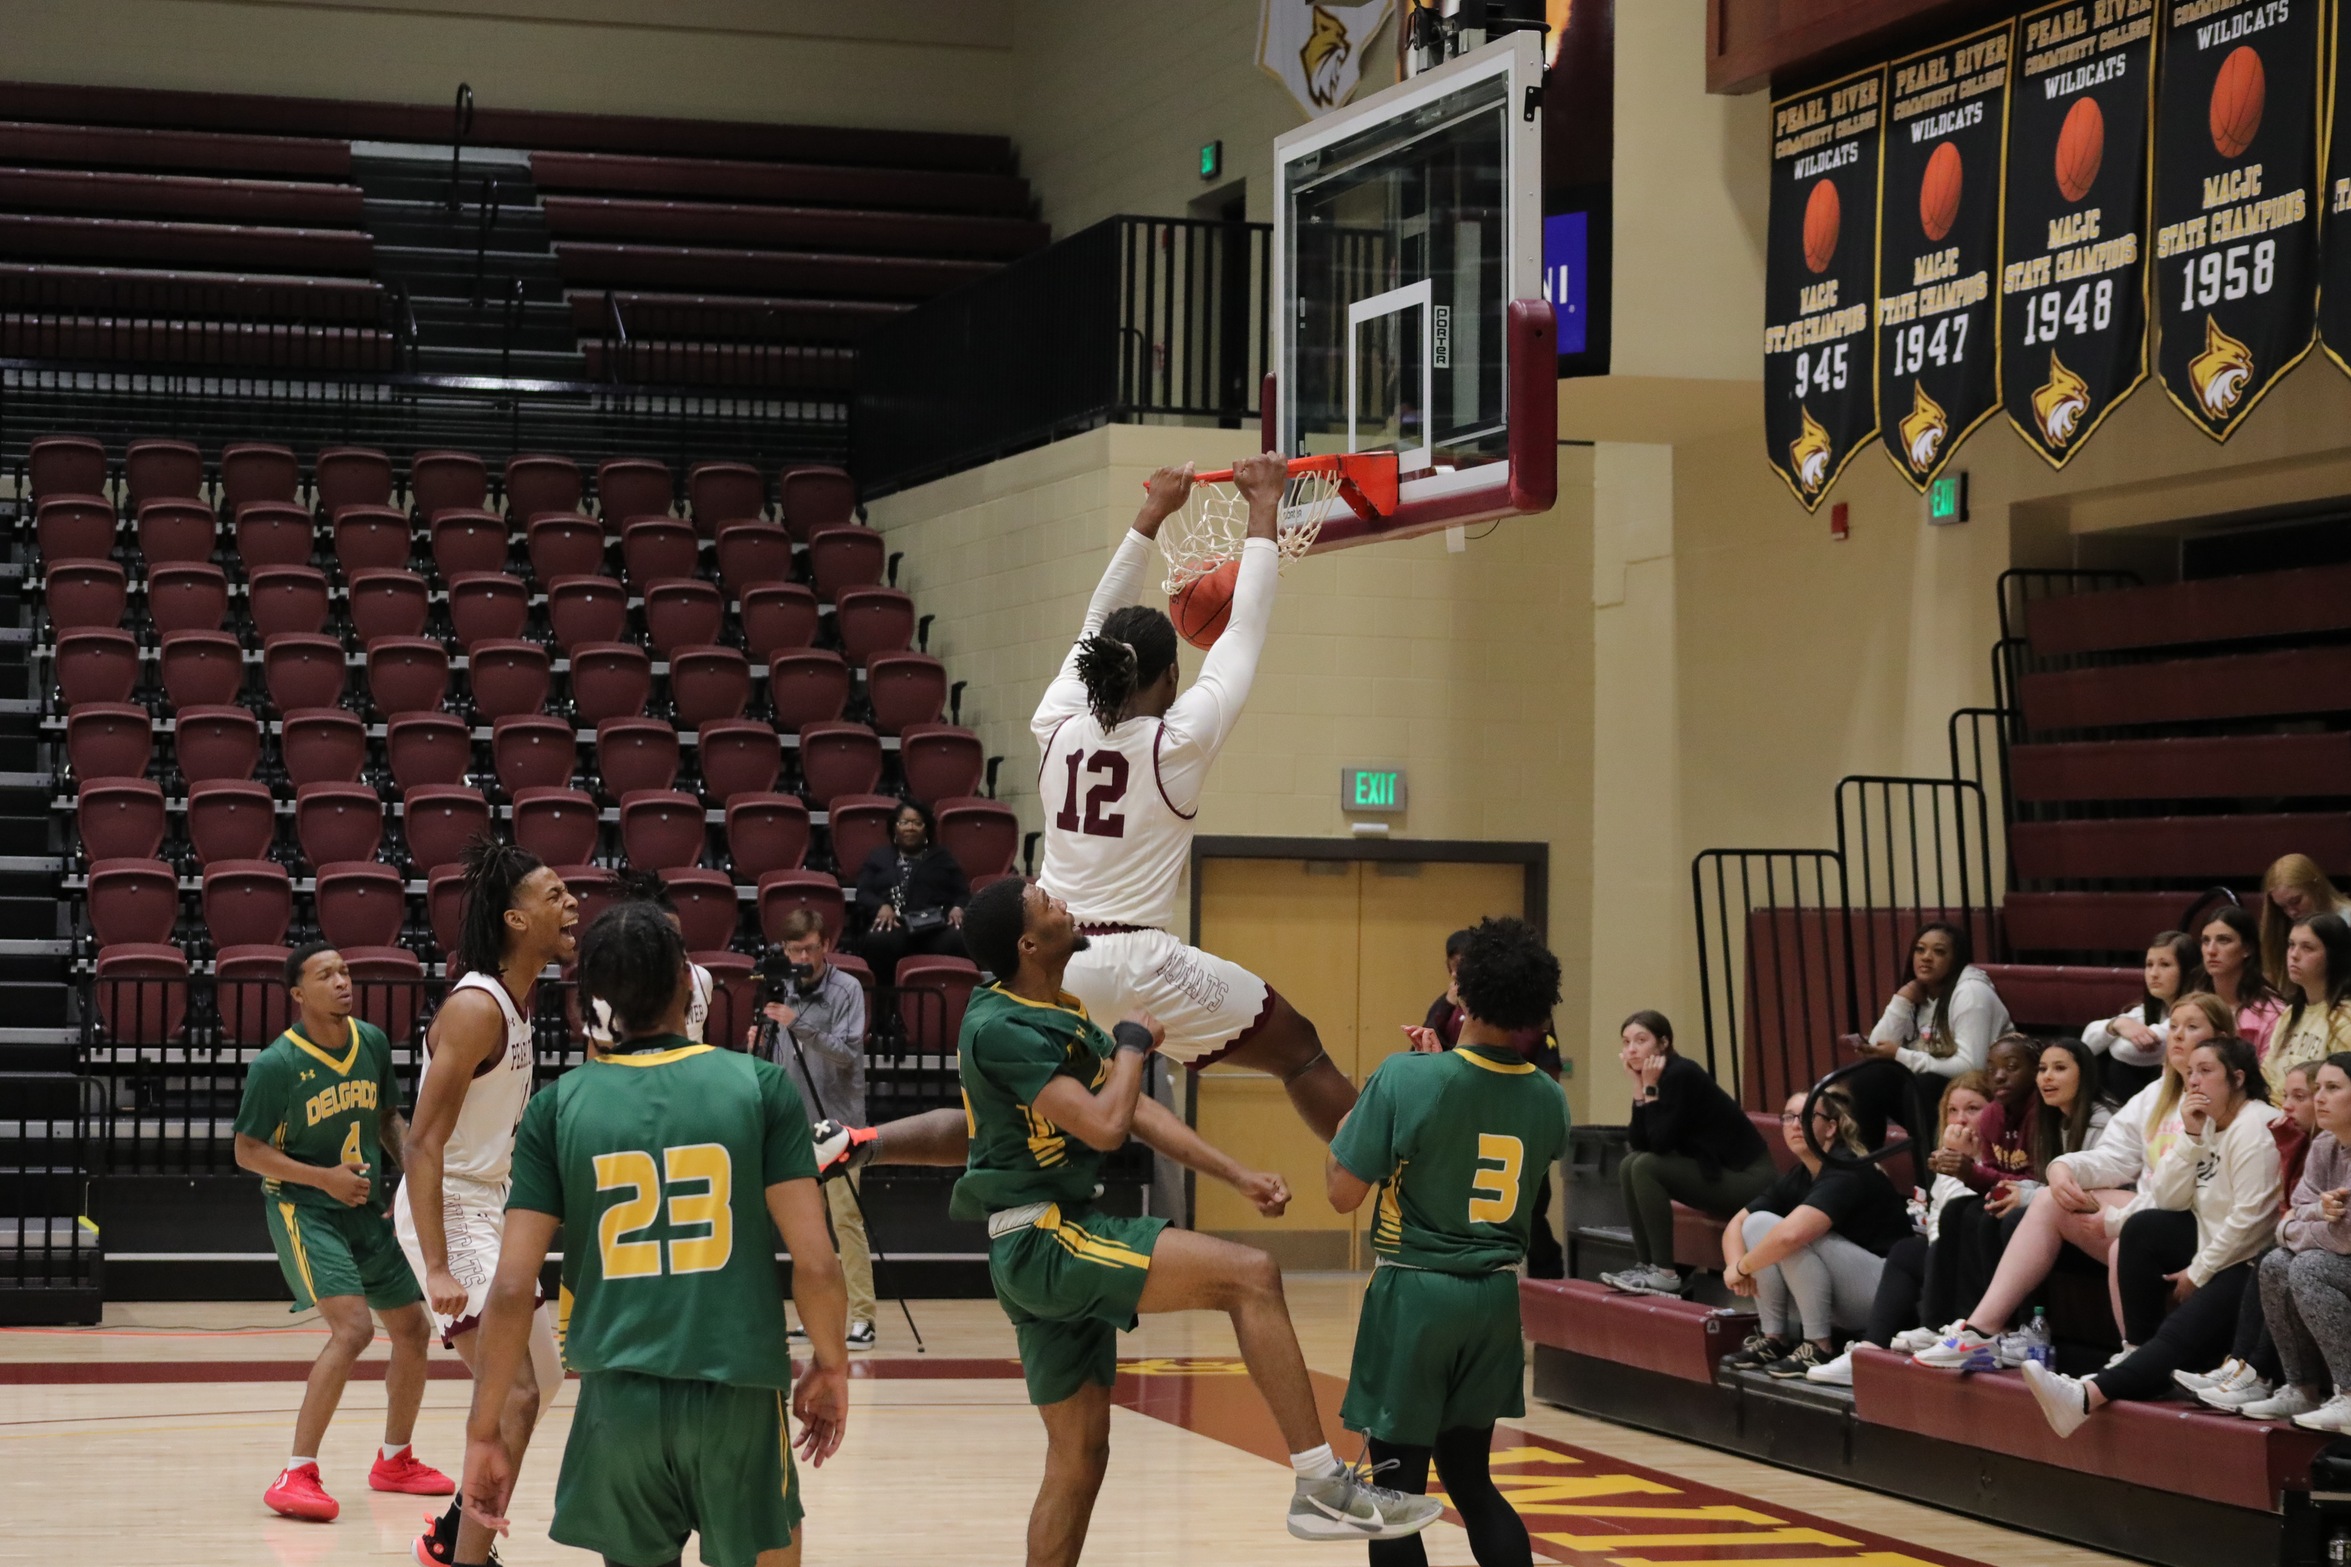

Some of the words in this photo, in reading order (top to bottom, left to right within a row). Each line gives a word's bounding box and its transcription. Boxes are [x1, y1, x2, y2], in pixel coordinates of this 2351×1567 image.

[2024, 35, 2098, 77] COMMUNITY
[2098, 16, 2152, 52] COLLEGE
[2025, 6, 2088, 52] PEARL
[2196, 0, 2290, 51] WILDCATS
[1894, 56, 1950, 98] PEARL
[1953, 34, 2008, 78] RIVER
[1958, 67, 2006, 99] COLLEGE
[2044, 53, 2127, 100] WILDCATS
[1776, 97, 1827, 138] PEARL
[1830, 78, 1879, 119] RIVER
[1910, 101, 1984, 143] WILDCATS
[1794, 141, 1859, 180] WILDCATS
[2202, 163, 2263, 210] MACJC
[2157, 215, 2208, 259] STATE
[2210, 188, 2307, 244] CHAMPIONS
[2003, 255, 2052, 294] STATE
[2180, 239, 2276, 312] 1958
[2024, 278, 2113, 346] 1948
[1893, 313, 1970, 376] 1947
[1056, 749, 1130, 838] 12
[1355, 770, 1398, 806] EXIT
[305, 1079, 378, 1128] DELGADO
[340, 1120, 367, 1175] 4
[1468, 1132, 1525, 1224] 3
[592, 1142, 734, 1281] 23
